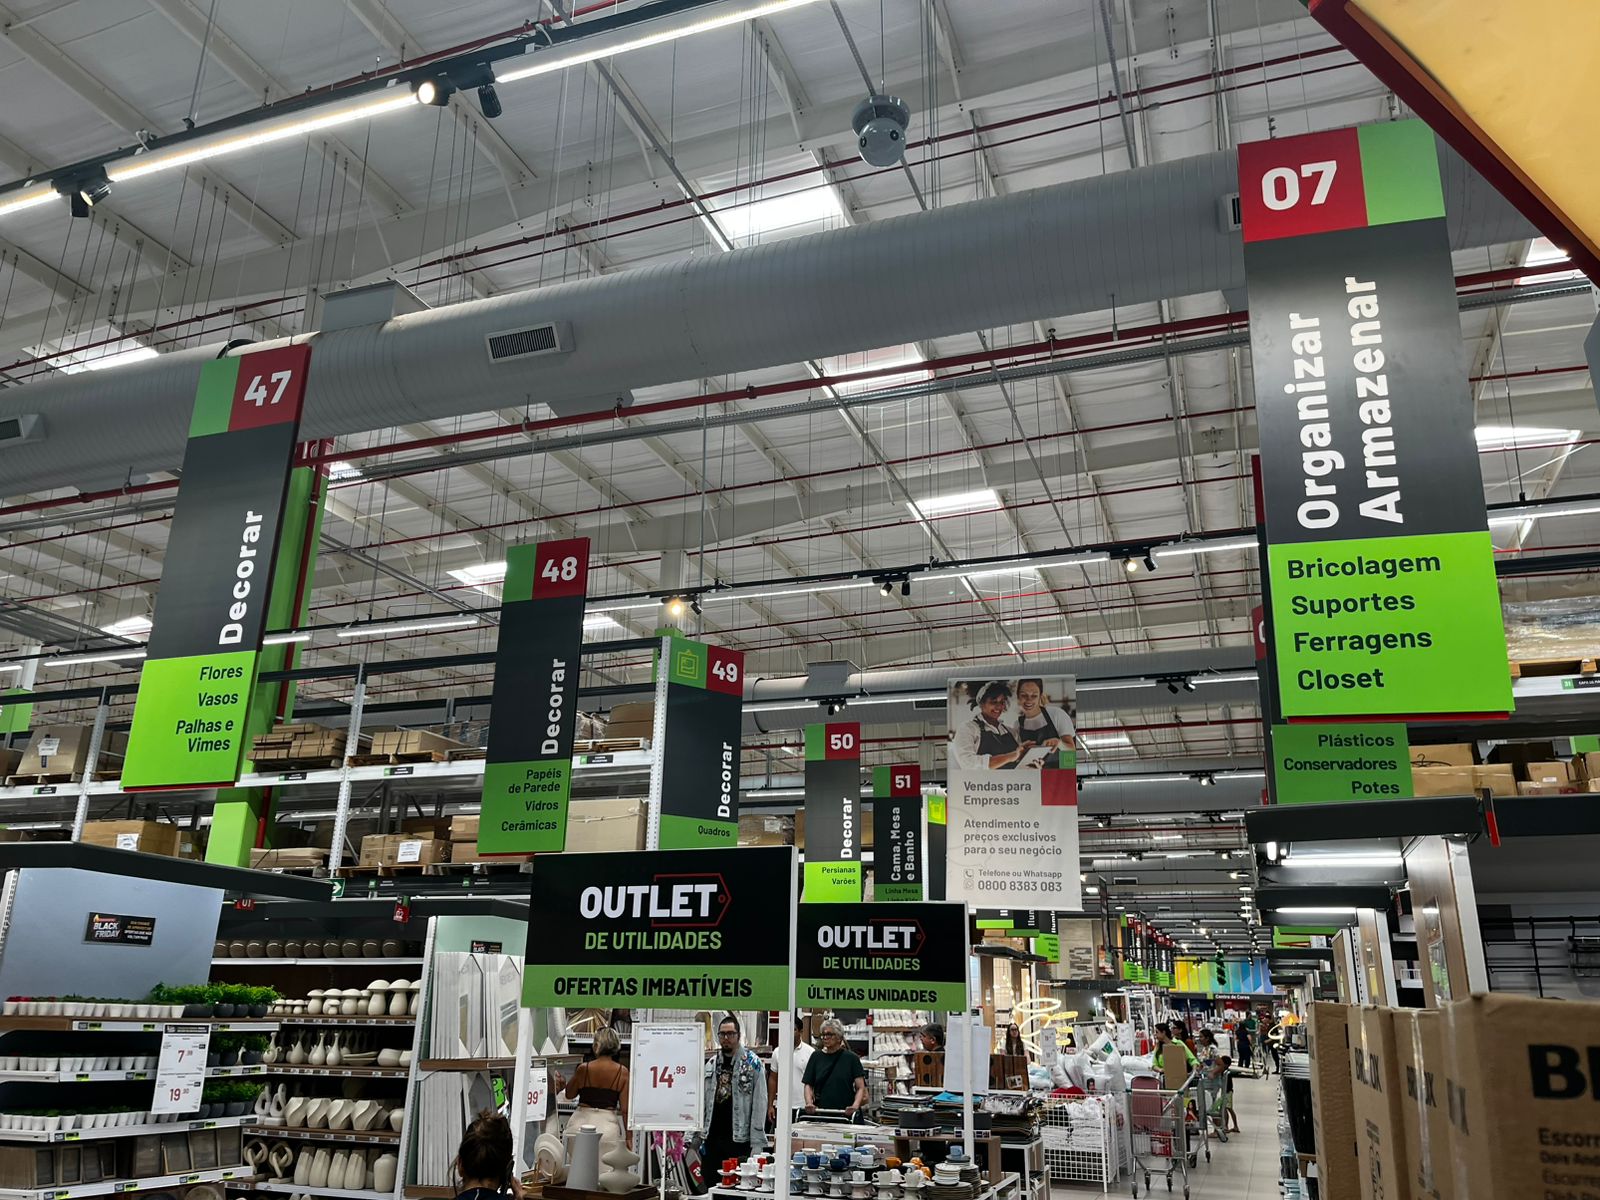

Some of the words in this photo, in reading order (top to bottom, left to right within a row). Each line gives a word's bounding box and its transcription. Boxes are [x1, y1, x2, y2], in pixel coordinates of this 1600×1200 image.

[1261, 160, 1338, 211] 07
[243, 370, 292, 406] 47
[1345, 276, 1404, 524] Armazenar
[1284, 312, 1345, 530] Organizar
[541, 556, 578, 583] 48
[1287, 555, 1441, 579] Bricolagem
[218, 510, 264, 645] Decorar
[1291, 593, 1416, 618] Suportes
[1293, 631, 1433, 655] Ferragens
[199, 665, 244, 681] Flores
[712, 660, 738, 683] 49
[1297, 668, 1385, 691] Closet
[198, 692, 239, 707] Vasos
[540, 657, 567, 755] Decorar
[175, 718, 222, 735] Palhas
[225, 720, 234, 732] e
[187, 737, 231, 752] Vimes
[830, 733, 854, 750] 50
[1317, 733, 1395, 748] Plásticos
[1283, 758, 1398, 772] Conservadores
[526, 767, 562, 780] Papéis
[717, 741, 733, 818] Decorar
[895, 774, 911, 789] 51
[508, 782, 521, 794] de
[523, 781, 561, 793] Parede
[963, 781, 1004, 791] Vendas
[1006, 782, 1032, 793] para
[1351, 781, 1400, 795] Potes
[525, 800, 559, 812] Vidros
[963, 795, 1020, 807] Empresas
[501, 818, 557, 832] Cerâmicas
[840, 797, 853, 859] Decorar
[890, 806, 901, 839] Mesa
[963, 819, 1031, 829] Atendimento
[1033, 821, 1040, 829] e
[697, 825, 731, 838] Quadros
[963, 833, 1000, 843] preços
[1001, 832, 1057, 842] exclusivos
[904, 830, 915, 871] Banho
[963, 846, 987, 856] para
[1019, 845, 1062, 857] negócio
[890, 841, 902, 881] Cama,
[821, 866, 856, 874] Persianas
[906, 873, 915, 881] e
[978, 869, 1011, 877] Telefone
[1023, 870, 1062, 879] Whatsapp
[831, 877, 856, 886] Varões
[977, 880, 1007, 891] 0800
[1009, 881, 1038, 892] 8383
[1040, 881, 1062, 892] 083
[579, 883, 719, 920] OUTLET
[93, 922, 119, 930] BLACK
[94, 930, 120, 938] FRIDAY
[585, 932, 609, 950] DE
[612, 930, 722, 950] UTILIDADES
[817, 925, 918, 949] OUTLET
[823, 957, 841, 970] DE
[843, 957, 921, 971] UTILIDADES
[553, 976, 639, 996] OFERTAS
[642, 972, 753, 997] IMBATÍVEIS
[807, 984, 866, 1002] ÚLTIMAS
[868, 987, 938, 1003] UNIDADES
